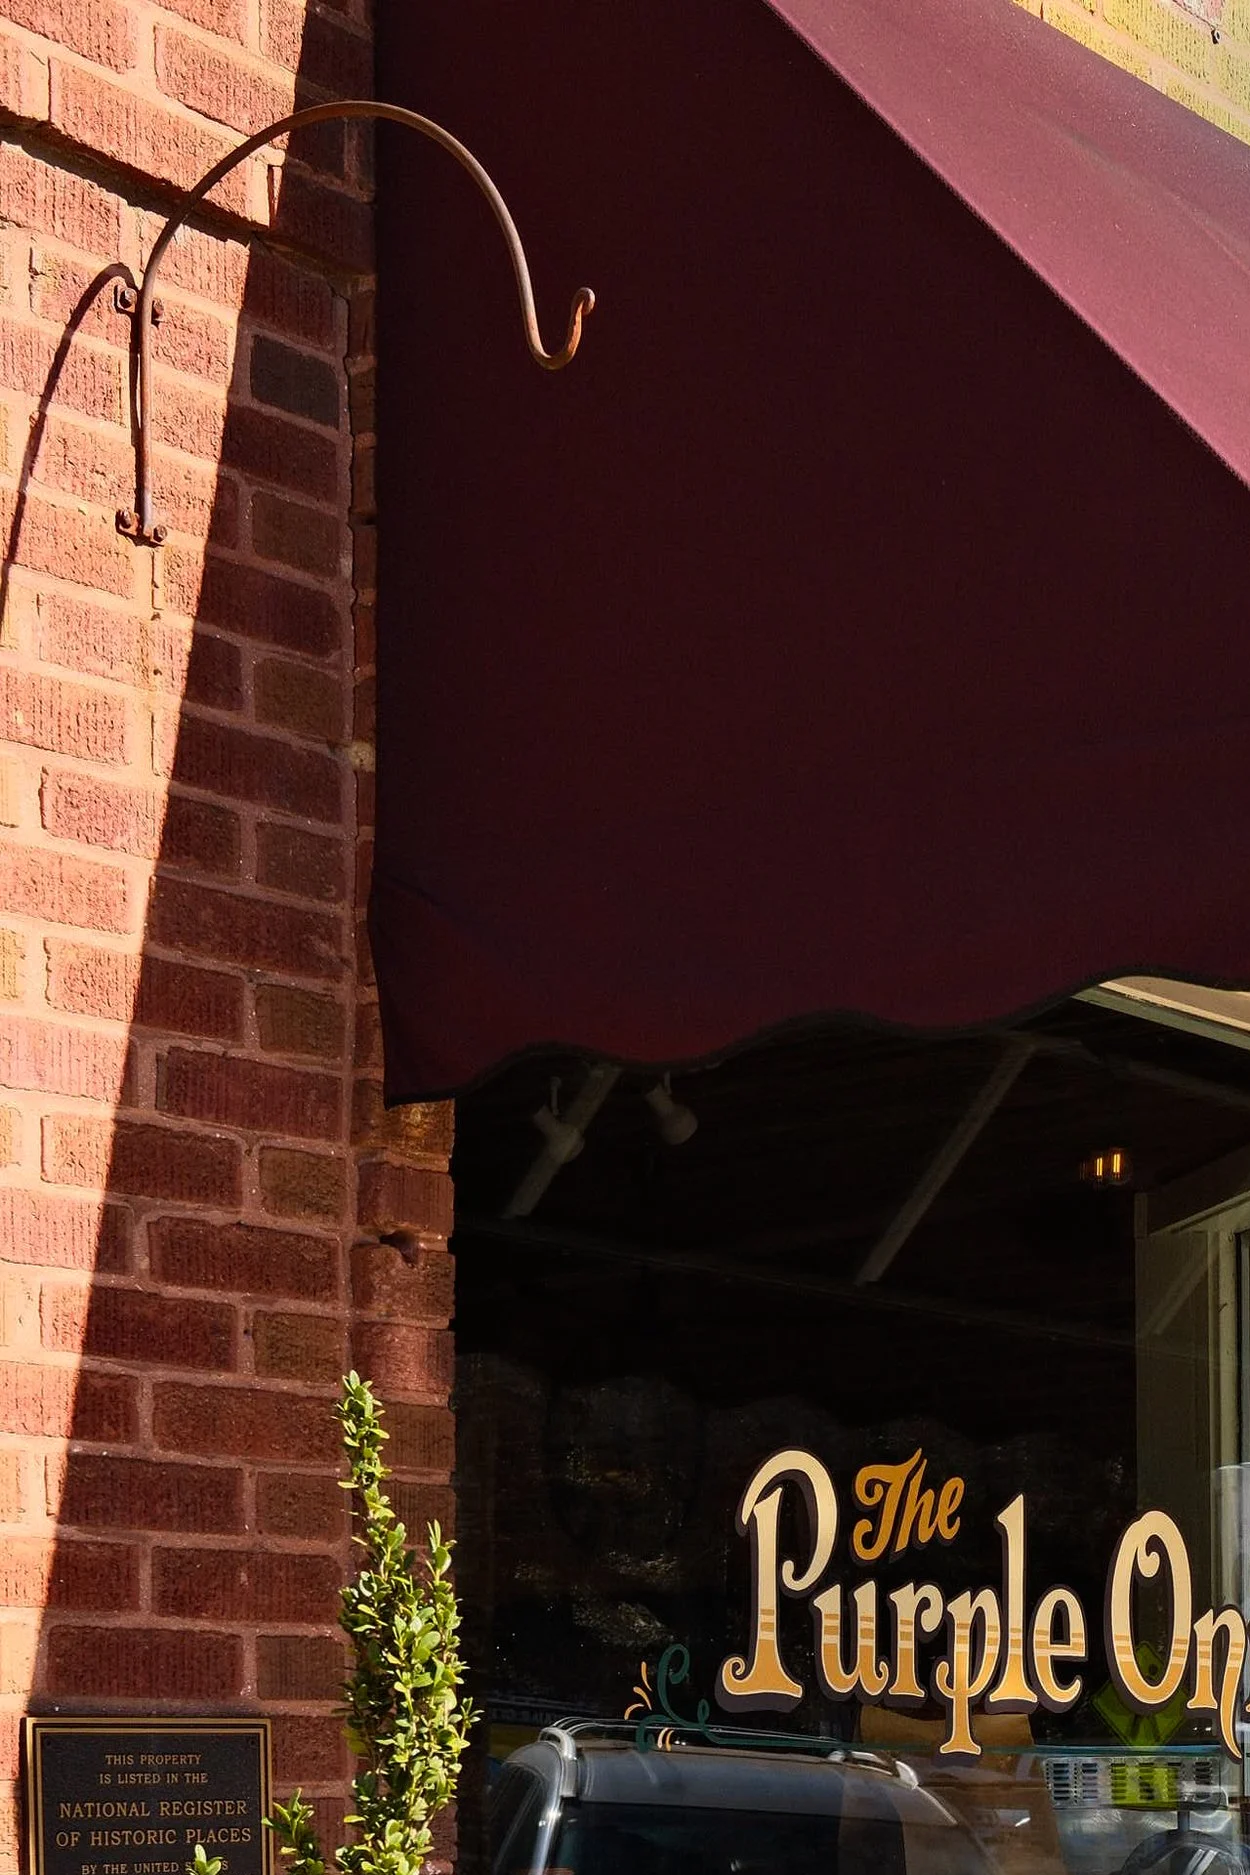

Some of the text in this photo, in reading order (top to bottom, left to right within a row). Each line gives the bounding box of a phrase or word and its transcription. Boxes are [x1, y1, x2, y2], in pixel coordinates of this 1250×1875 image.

[851, 1447, 966, 1561] The
[717, 1449, 1088, 1756] Purple
[105, 1754, 202, 1766] THIS PROPERTY
[100, 1772, 209, 1785] IS LISTED IN THE
[60, 1800, 248, 1818] NATIONAL REGISTER
[56, 1827, 251, 1847] OF HISTORIC PLACES
[81, 1864, 98, 1875] BY
[103, 1863, 128, 1875] THE
[134, 1862, 179, 1873] UNITED
